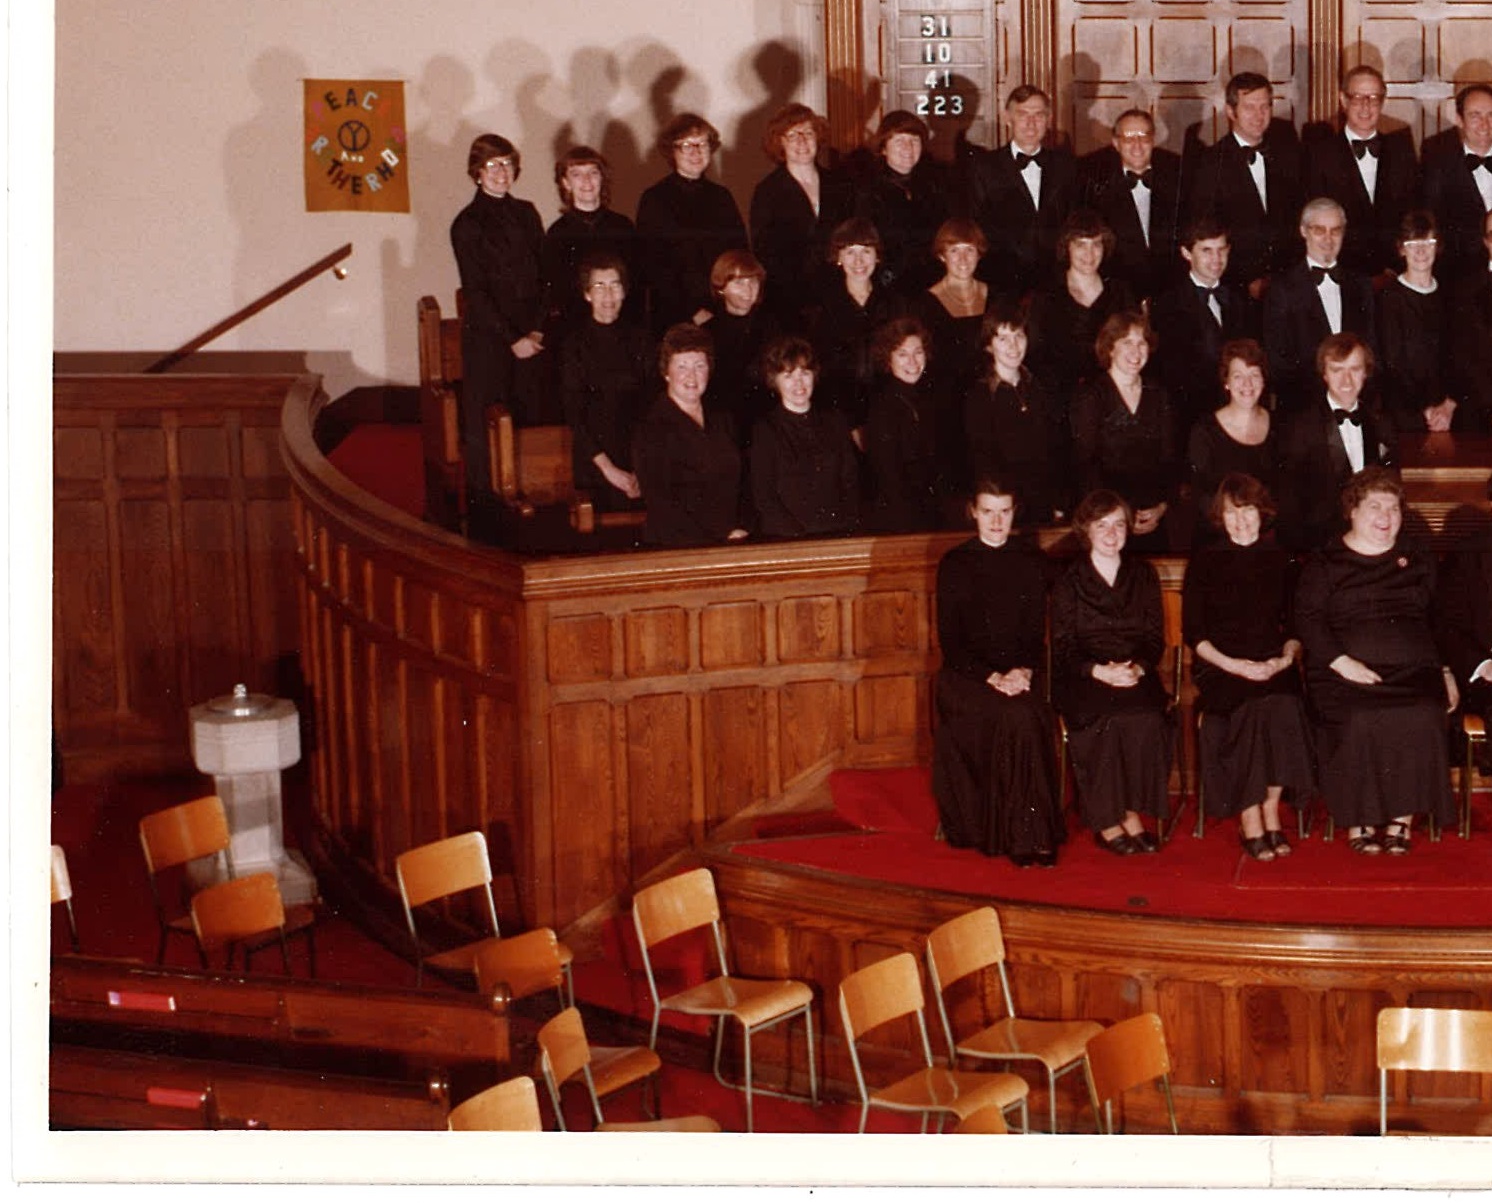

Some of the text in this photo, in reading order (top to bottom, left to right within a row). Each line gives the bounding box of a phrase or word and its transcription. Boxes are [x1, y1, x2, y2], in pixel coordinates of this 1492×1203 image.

[921, 15, 948, 36] 31
[926, 43, 951, 62] 10
[925, 70, 950, 88] 41
[916, 95, 963, 115] 223
